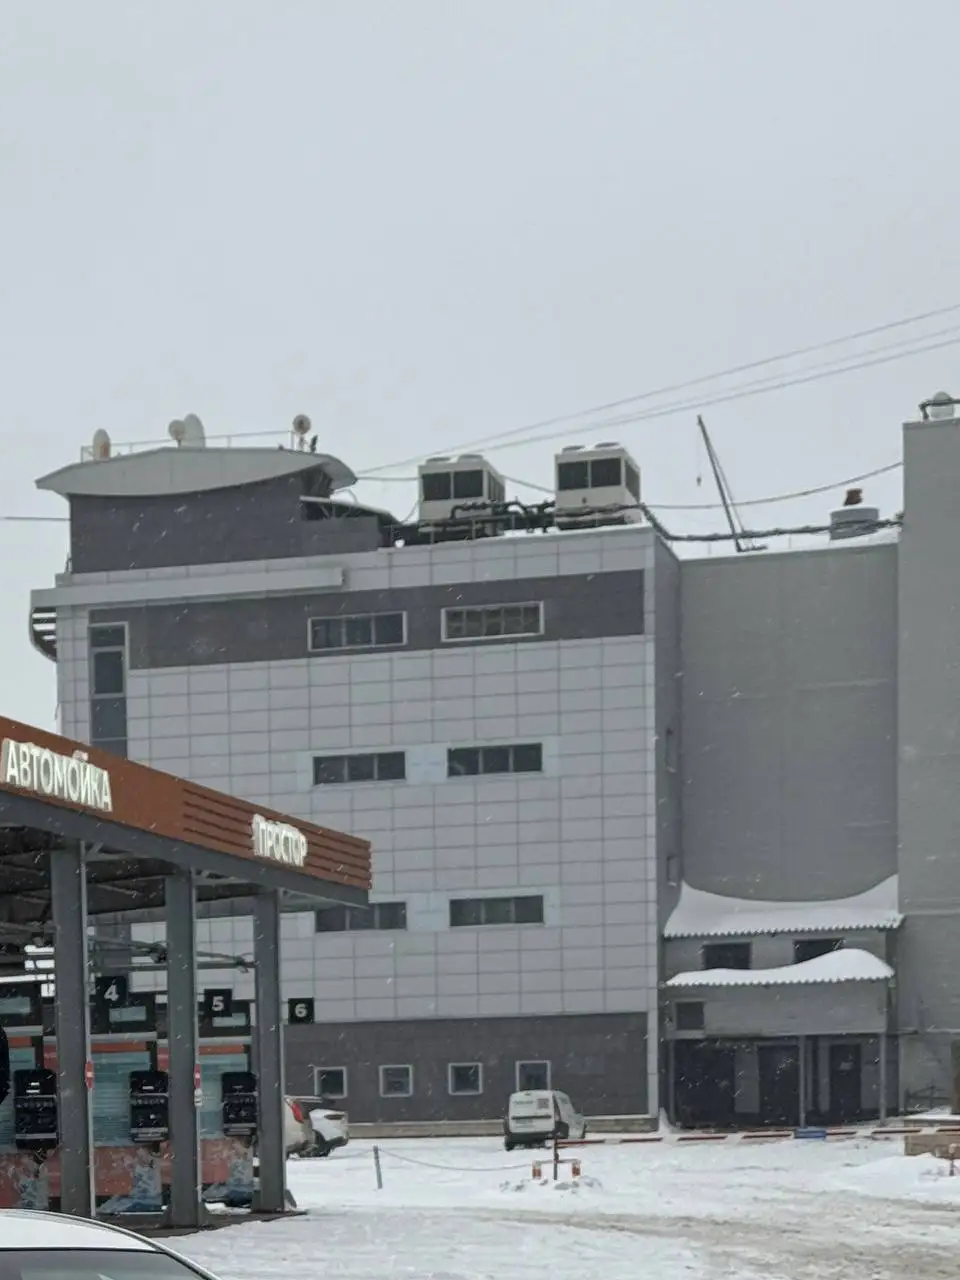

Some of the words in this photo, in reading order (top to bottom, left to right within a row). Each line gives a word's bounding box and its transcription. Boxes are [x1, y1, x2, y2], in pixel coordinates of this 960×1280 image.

[0, 737, 113, 812] АВТОМОЙКА
[252, 814, 308, 867] ПРОСТОР
[103, 984, 120, 1001] 4
[211, 995, 225, 1012] 5
[294, 1003, 308, 1018] 6
